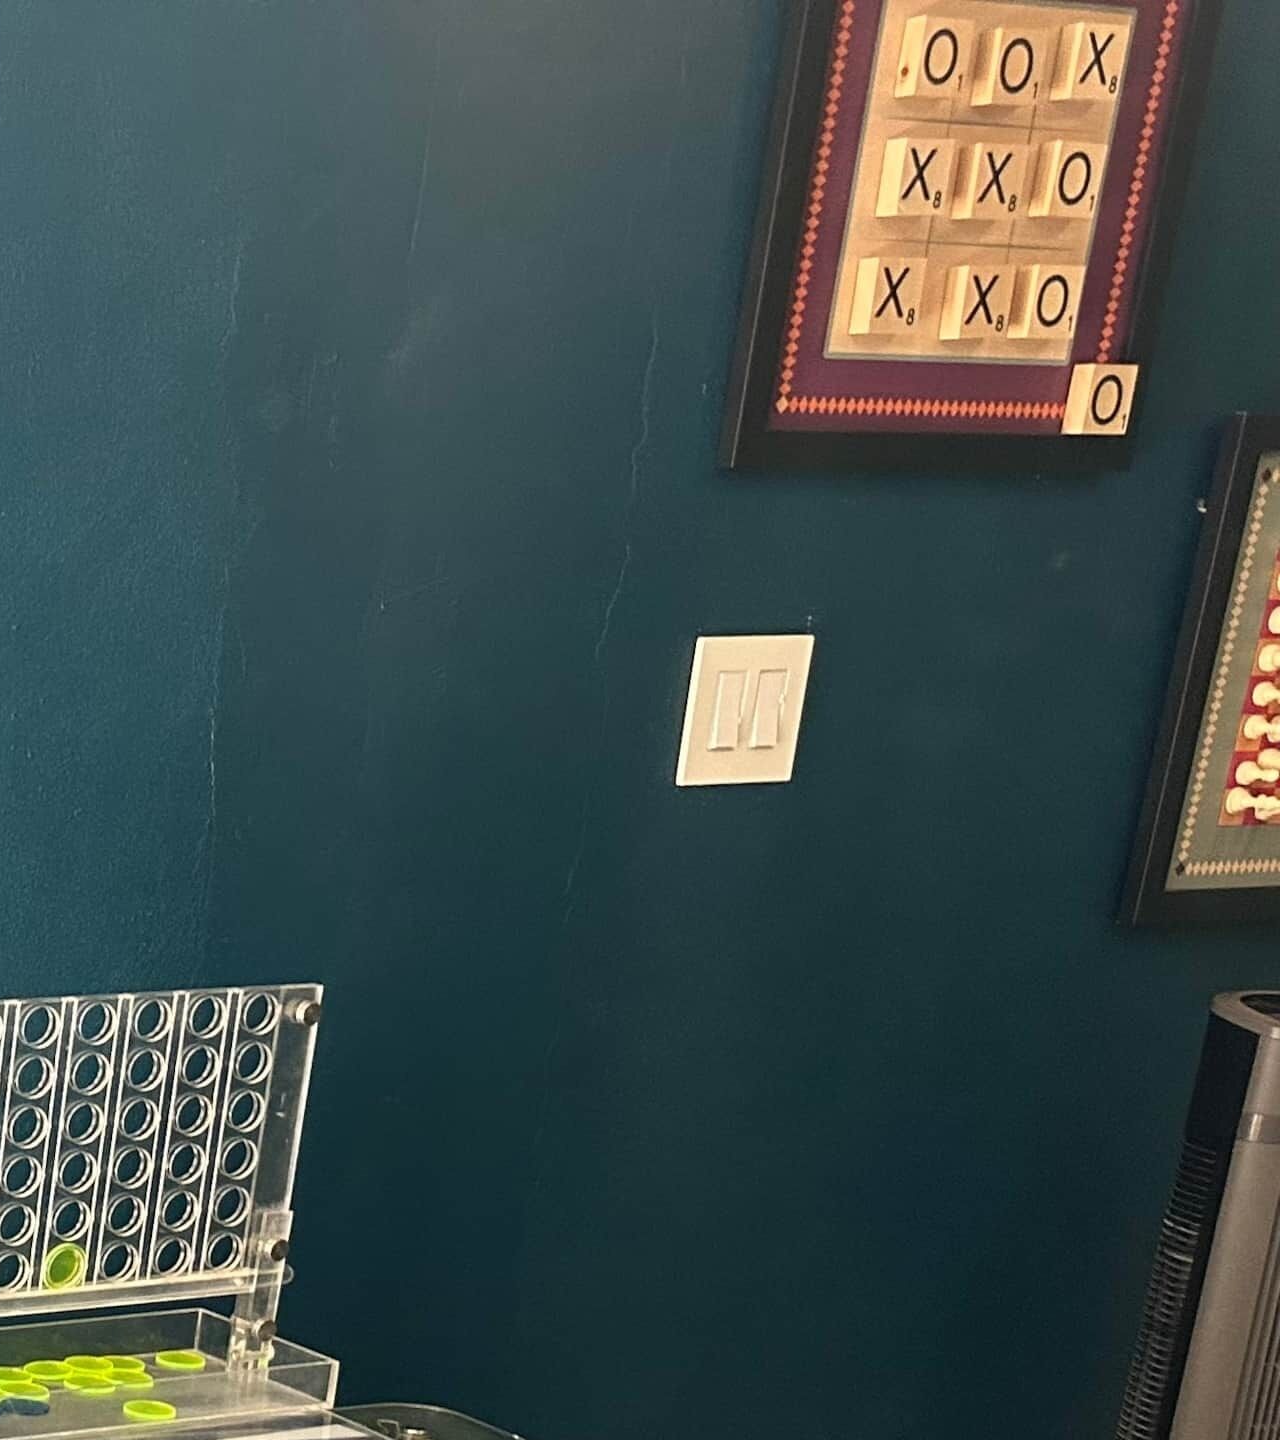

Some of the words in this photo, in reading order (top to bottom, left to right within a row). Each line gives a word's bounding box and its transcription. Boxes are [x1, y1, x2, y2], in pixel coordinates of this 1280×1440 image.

[1079, 31, 1115, 85] X
[901, 147, 938, 201] X
[976, 152, 1013, 204] X
[874, 266, 911, 319] X
[964, 275, 1000, 326] X
